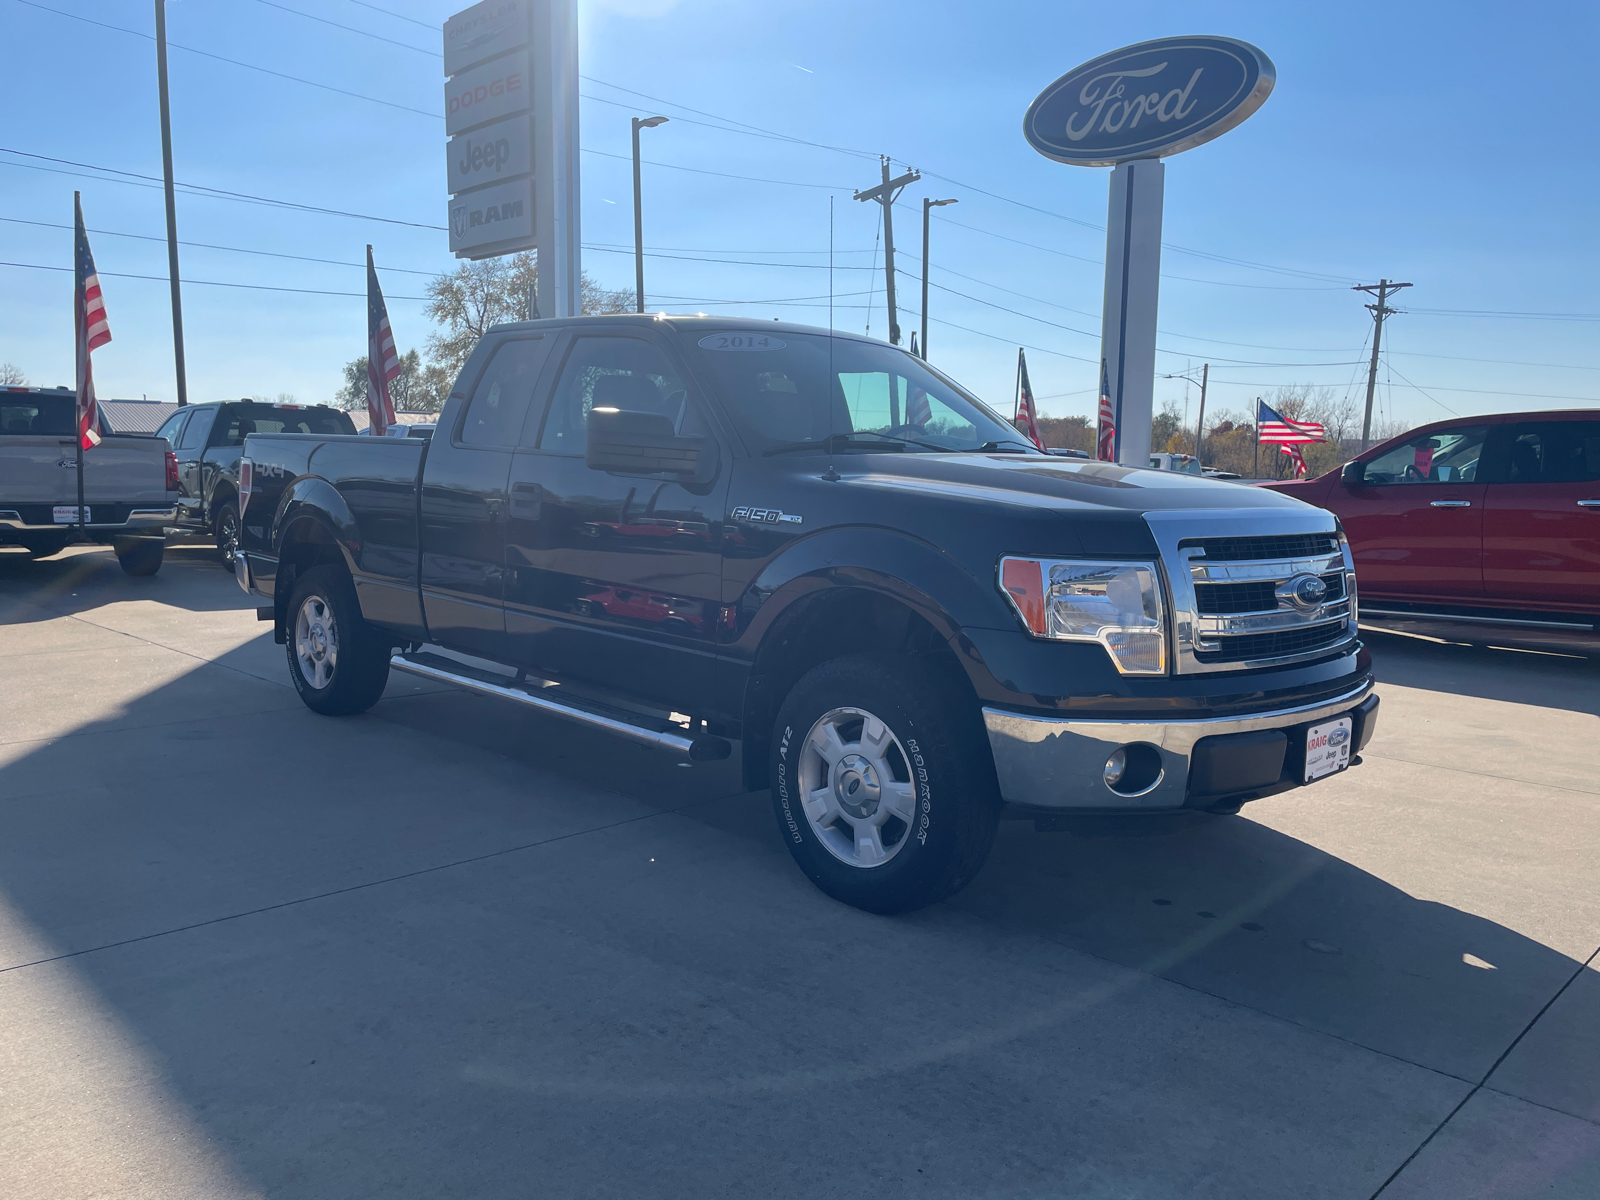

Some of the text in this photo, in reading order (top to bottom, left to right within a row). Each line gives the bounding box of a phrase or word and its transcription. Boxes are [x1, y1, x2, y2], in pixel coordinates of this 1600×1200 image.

[449, 2, 517, 40] CHRYSLER
[449, 72, 521, 115] DODGE
[1065, 61, 1204, 141] Ford
[459, 137, 510, 175] Jeep
[469, 200, 524, 228] RAM
[717, 336, 770, 349] 2014
[1307, 734, 1327, 752] KRAIG
[779, 725, 803, 844] Dynapro AT2
